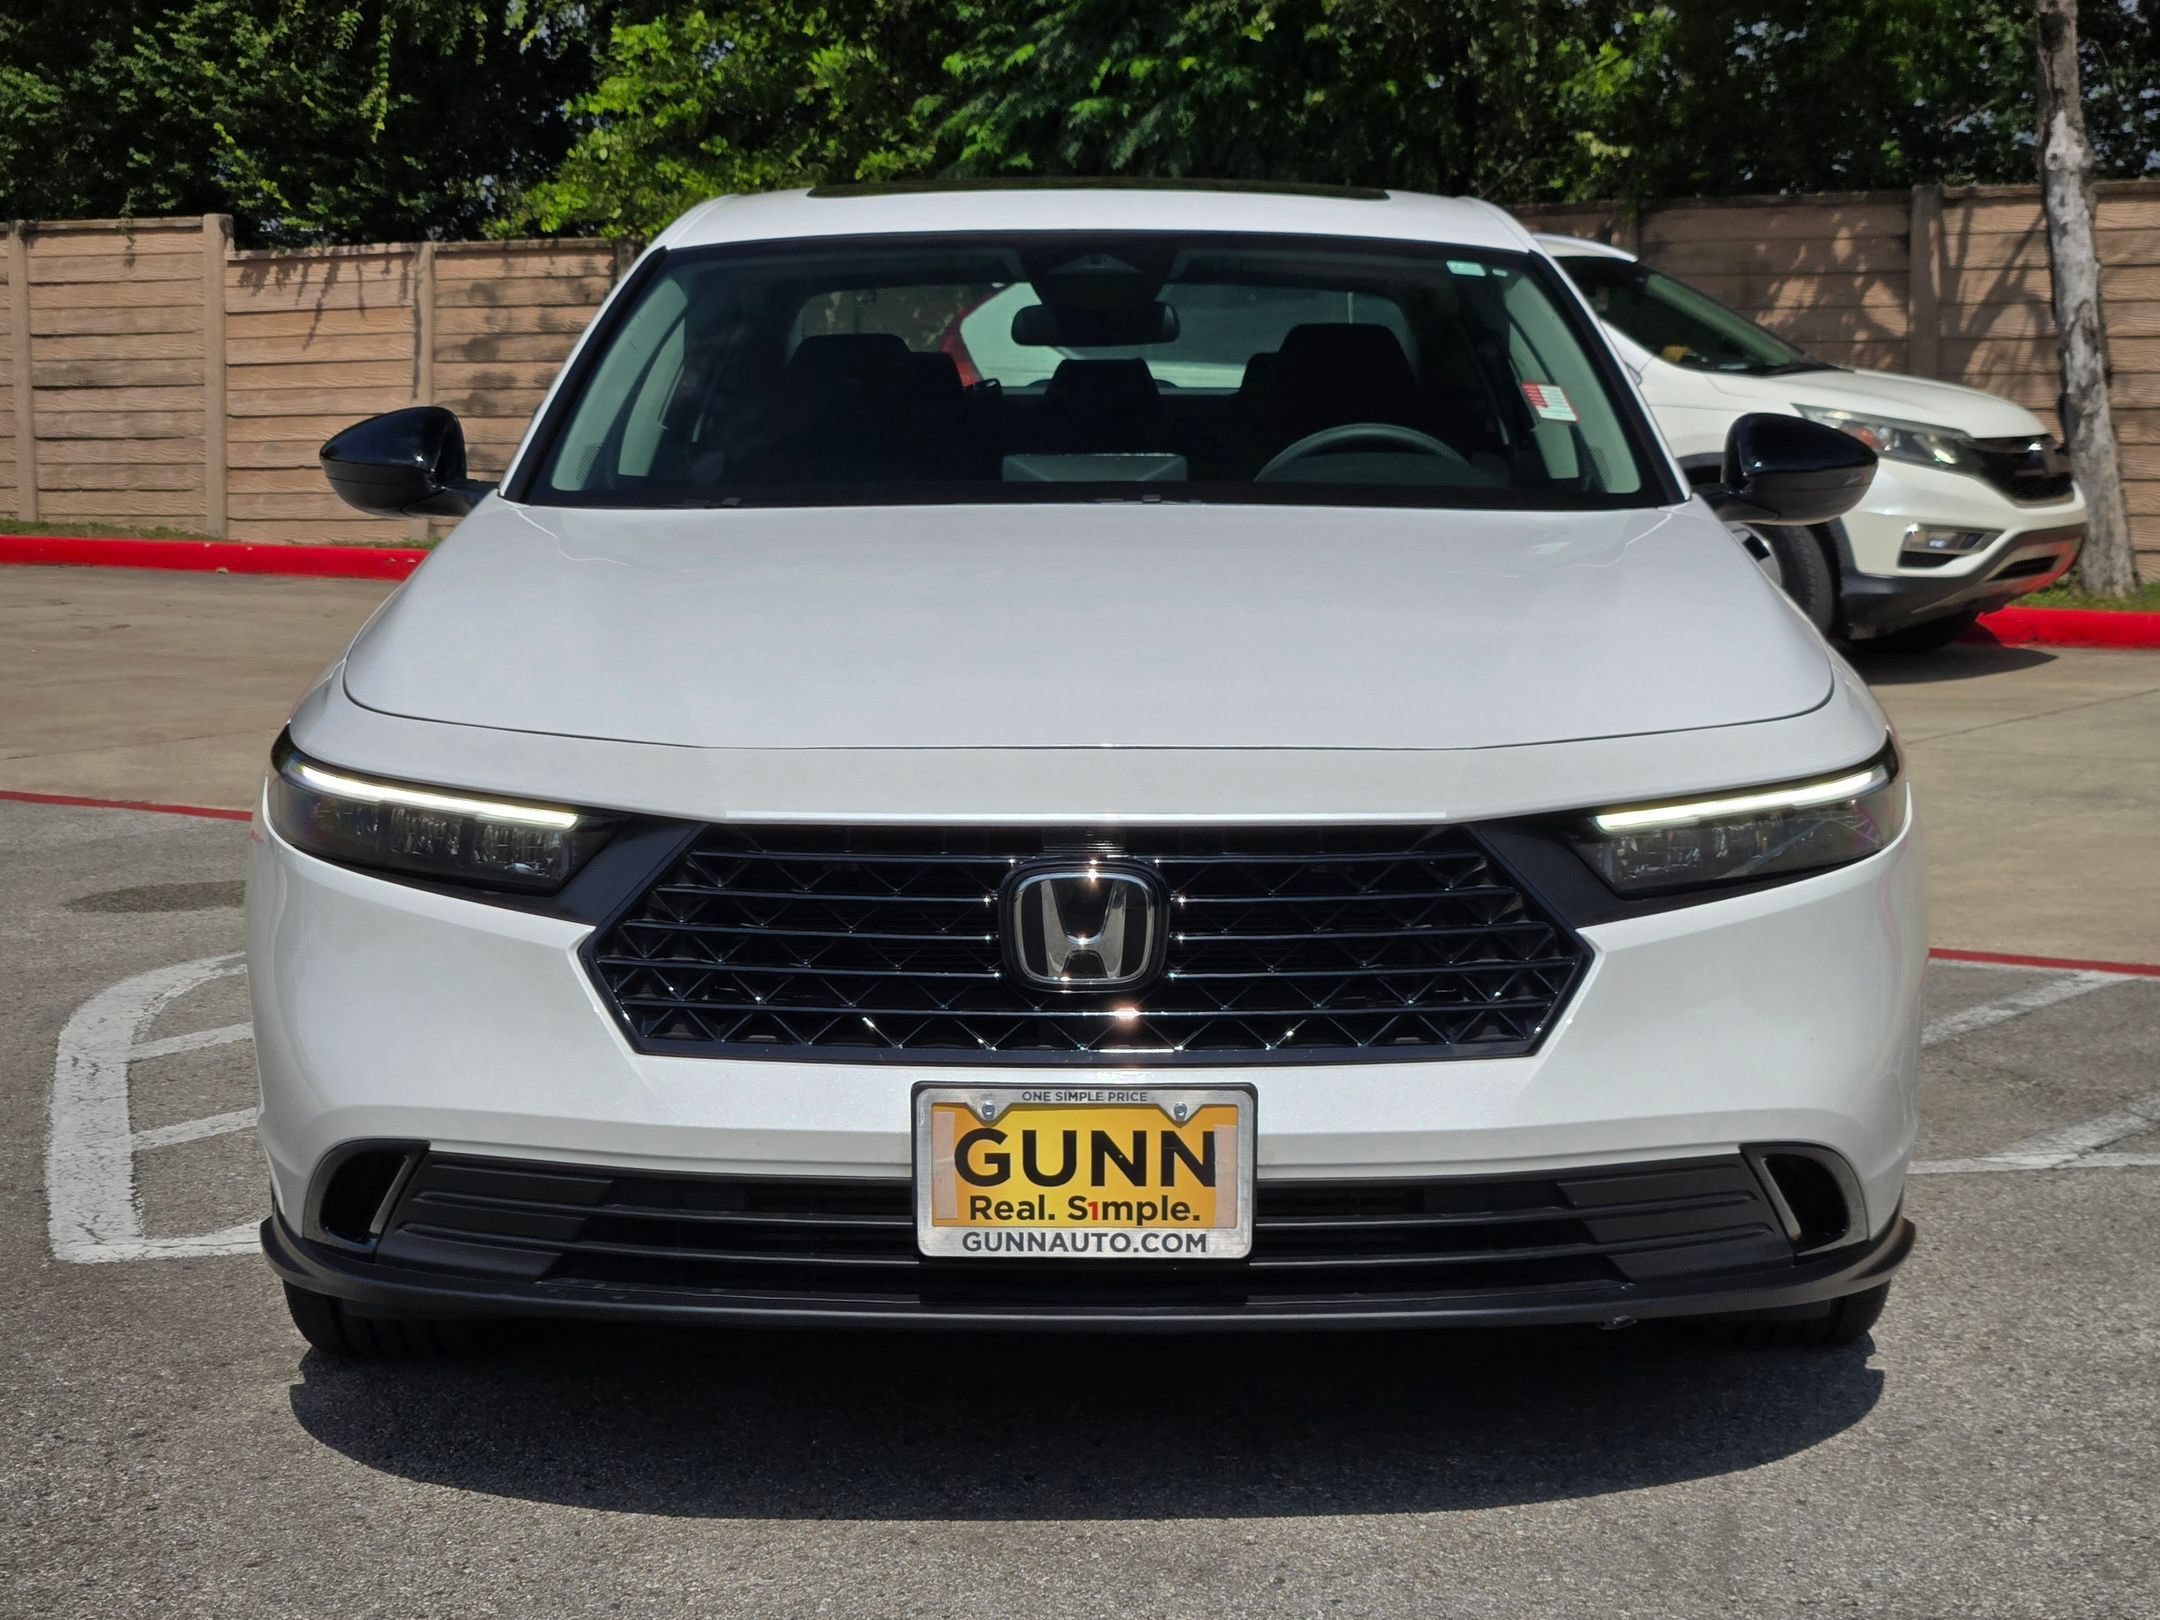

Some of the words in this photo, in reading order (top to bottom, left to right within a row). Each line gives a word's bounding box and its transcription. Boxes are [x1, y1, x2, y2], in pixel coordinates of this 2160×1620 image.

[1022, 1091, 1052, 1102] ONE
[1055, 1091, 1104, 1102] SIMPLE
[1108, 1091, 1147, 1102] PRICE
[954, 1128, 1216, 1188] GUNN
[969, 1194, 1055, 1221] Real.
[962, 1232, 1207, 1253] GUNNAUTO.COM
